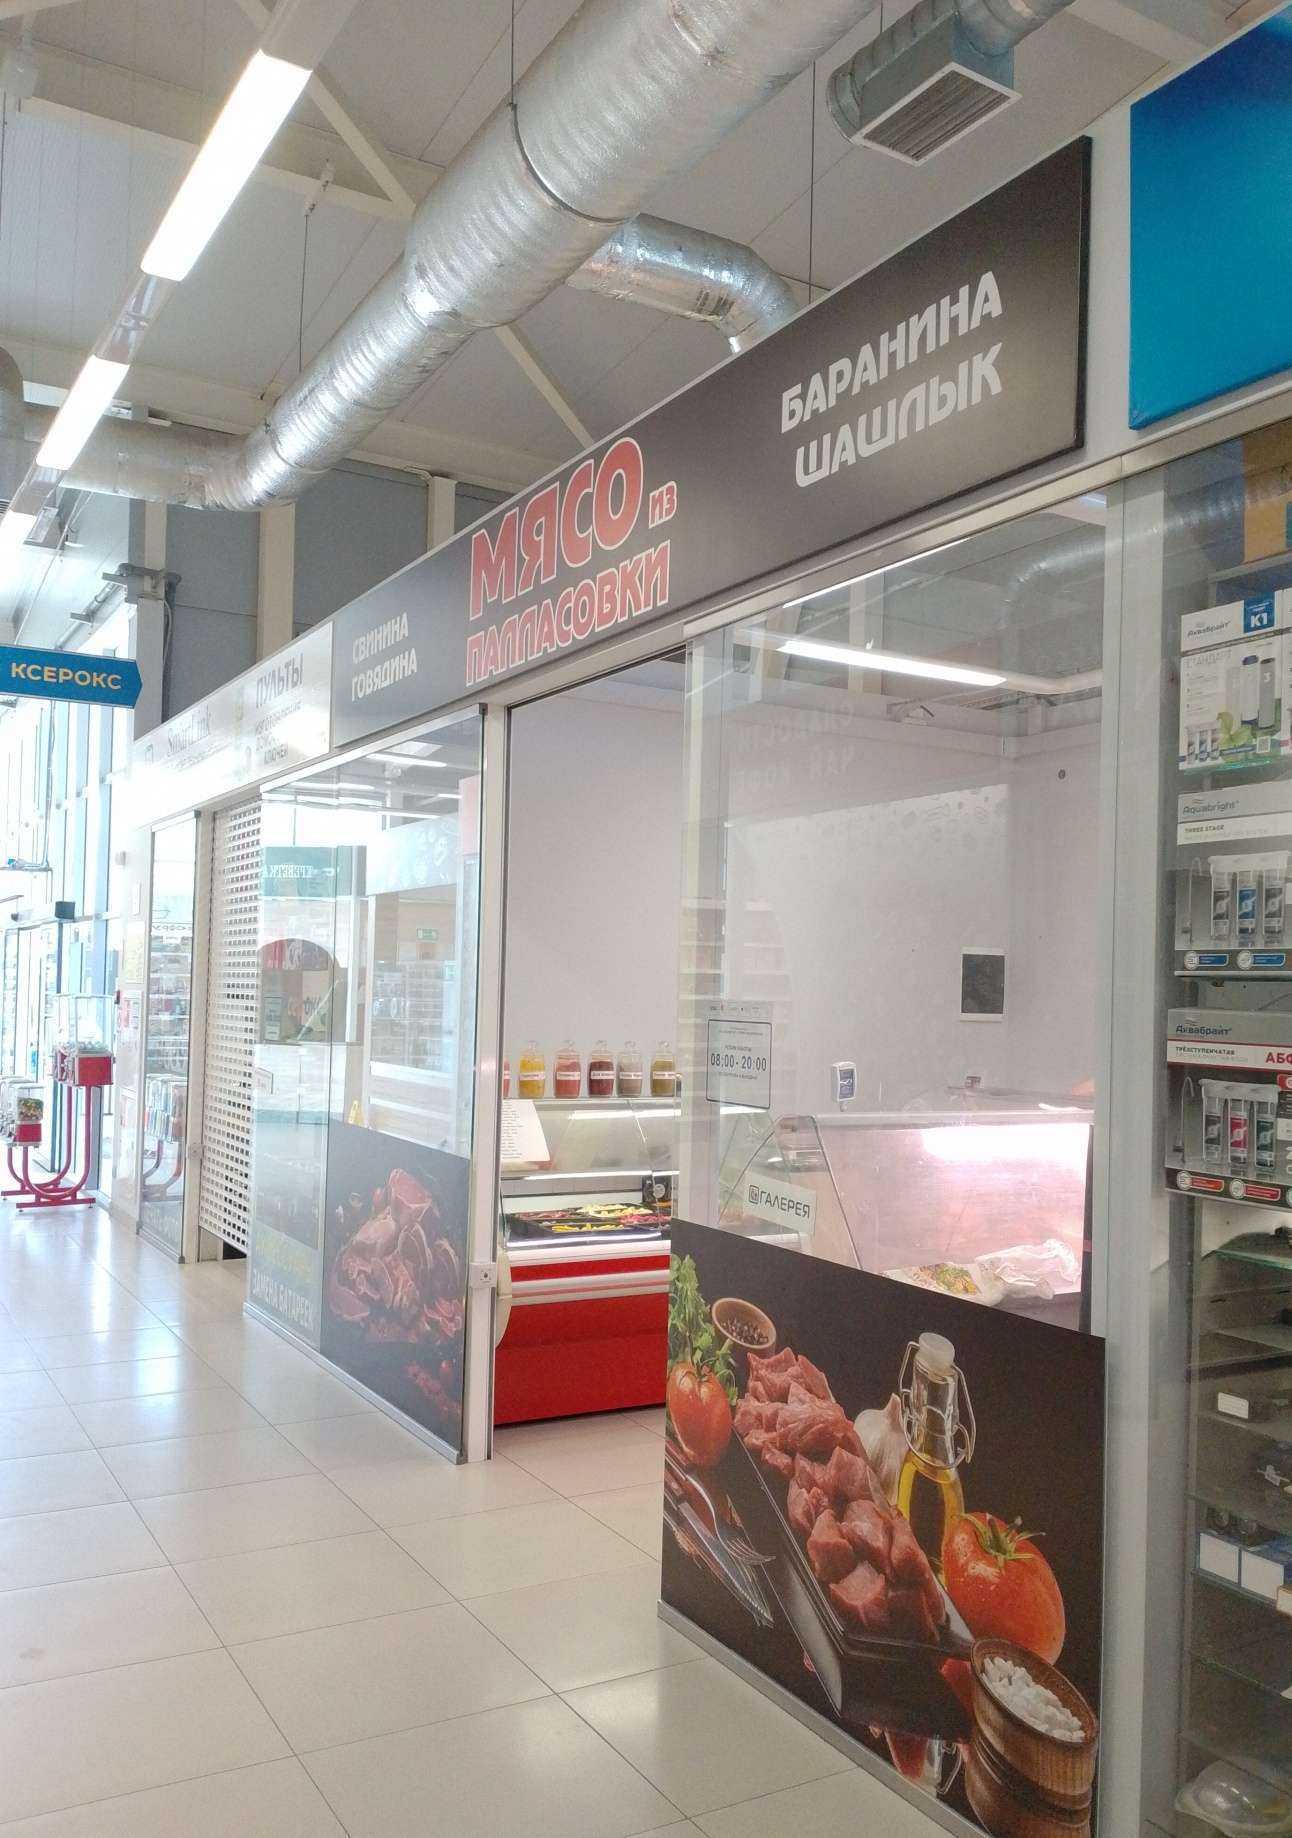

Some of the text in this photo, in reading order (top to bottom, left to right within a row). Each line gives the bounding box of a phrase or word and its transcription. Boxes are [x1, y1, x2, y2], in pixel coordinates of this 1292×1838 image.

[781, 271, 1003, 434] БАРАНИНА
[795, 342, 1003, 488] ШАШЛЫК
[469, 436, 677, 621] МЯСО ИЗ
[352, 612, 409, 665] СВИНИНА
[465, 539, 671, 687] ПАЛЛАСОВКИ
[10, 661, 123, 691] КСЕРОКС
[256, 652, 304, 709] ПУЛЬТЫ
[352, 647, 417, 702] ГОВЯДИНА
[741, 1055, 767, 1072] 20:00
[760, 1191, 810, 1219] ГАЛЕРЕЯ
